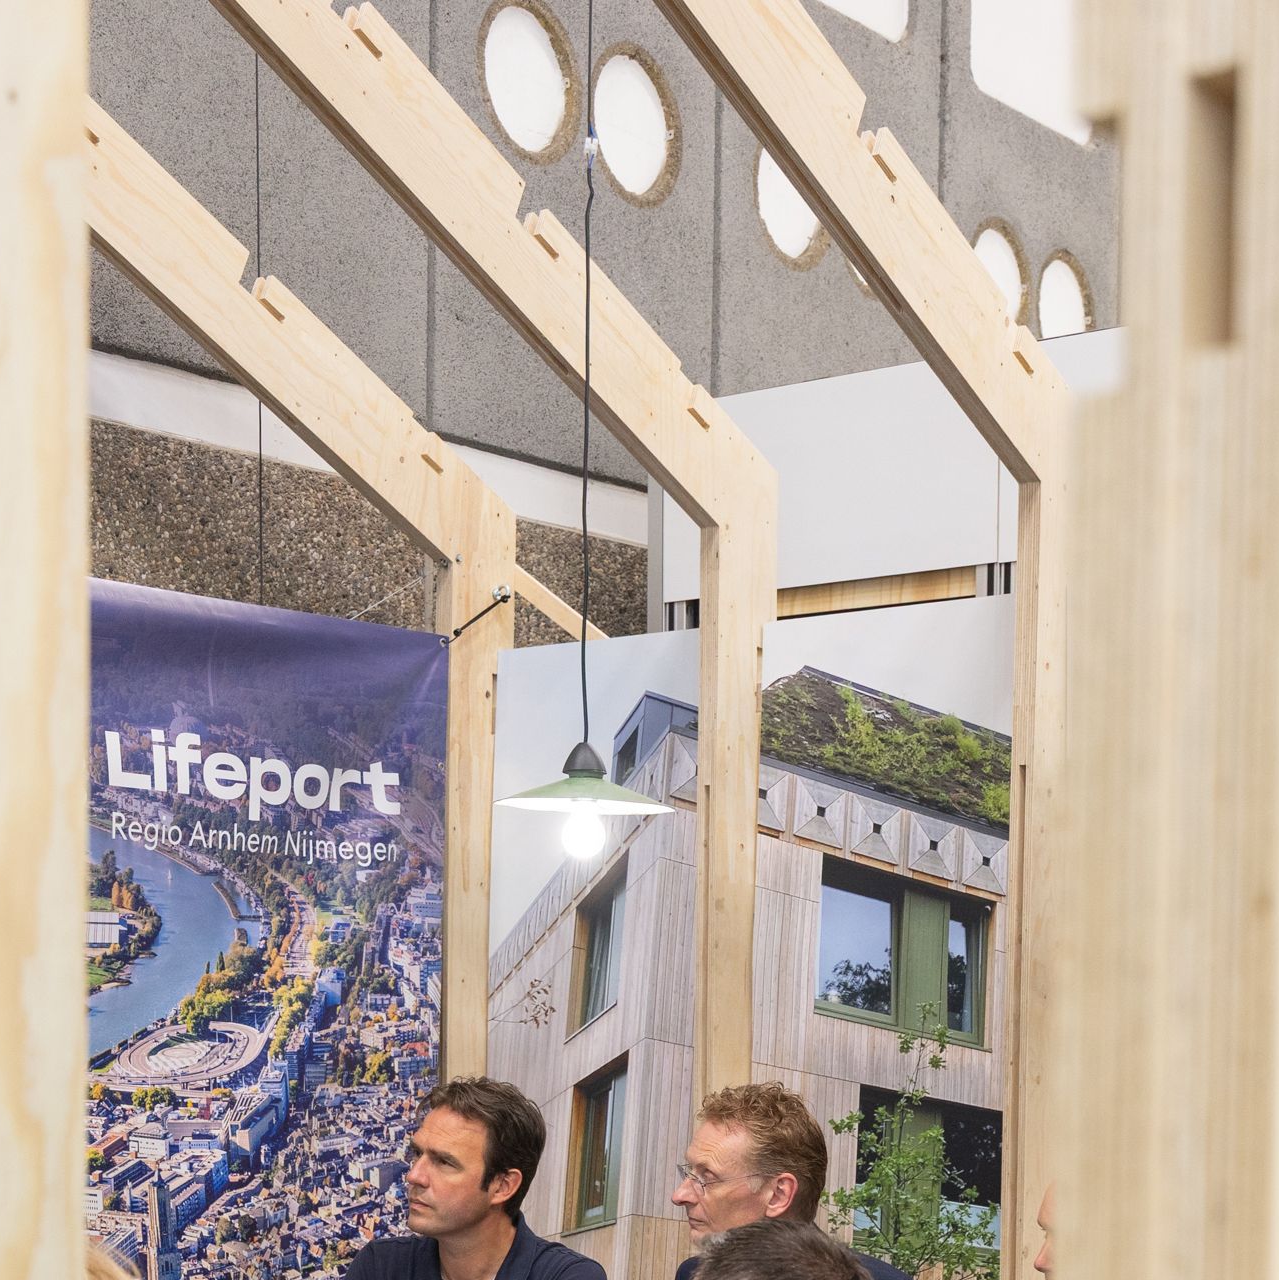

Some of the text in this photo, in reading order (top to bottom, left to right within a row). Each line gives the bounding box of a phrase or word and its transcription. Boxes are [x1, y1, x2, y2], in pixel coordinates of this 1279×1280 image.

[105, 729, 401, 821] Lifeport
[111, 812, 398, 867] Regio Arnhem Nijmegen
